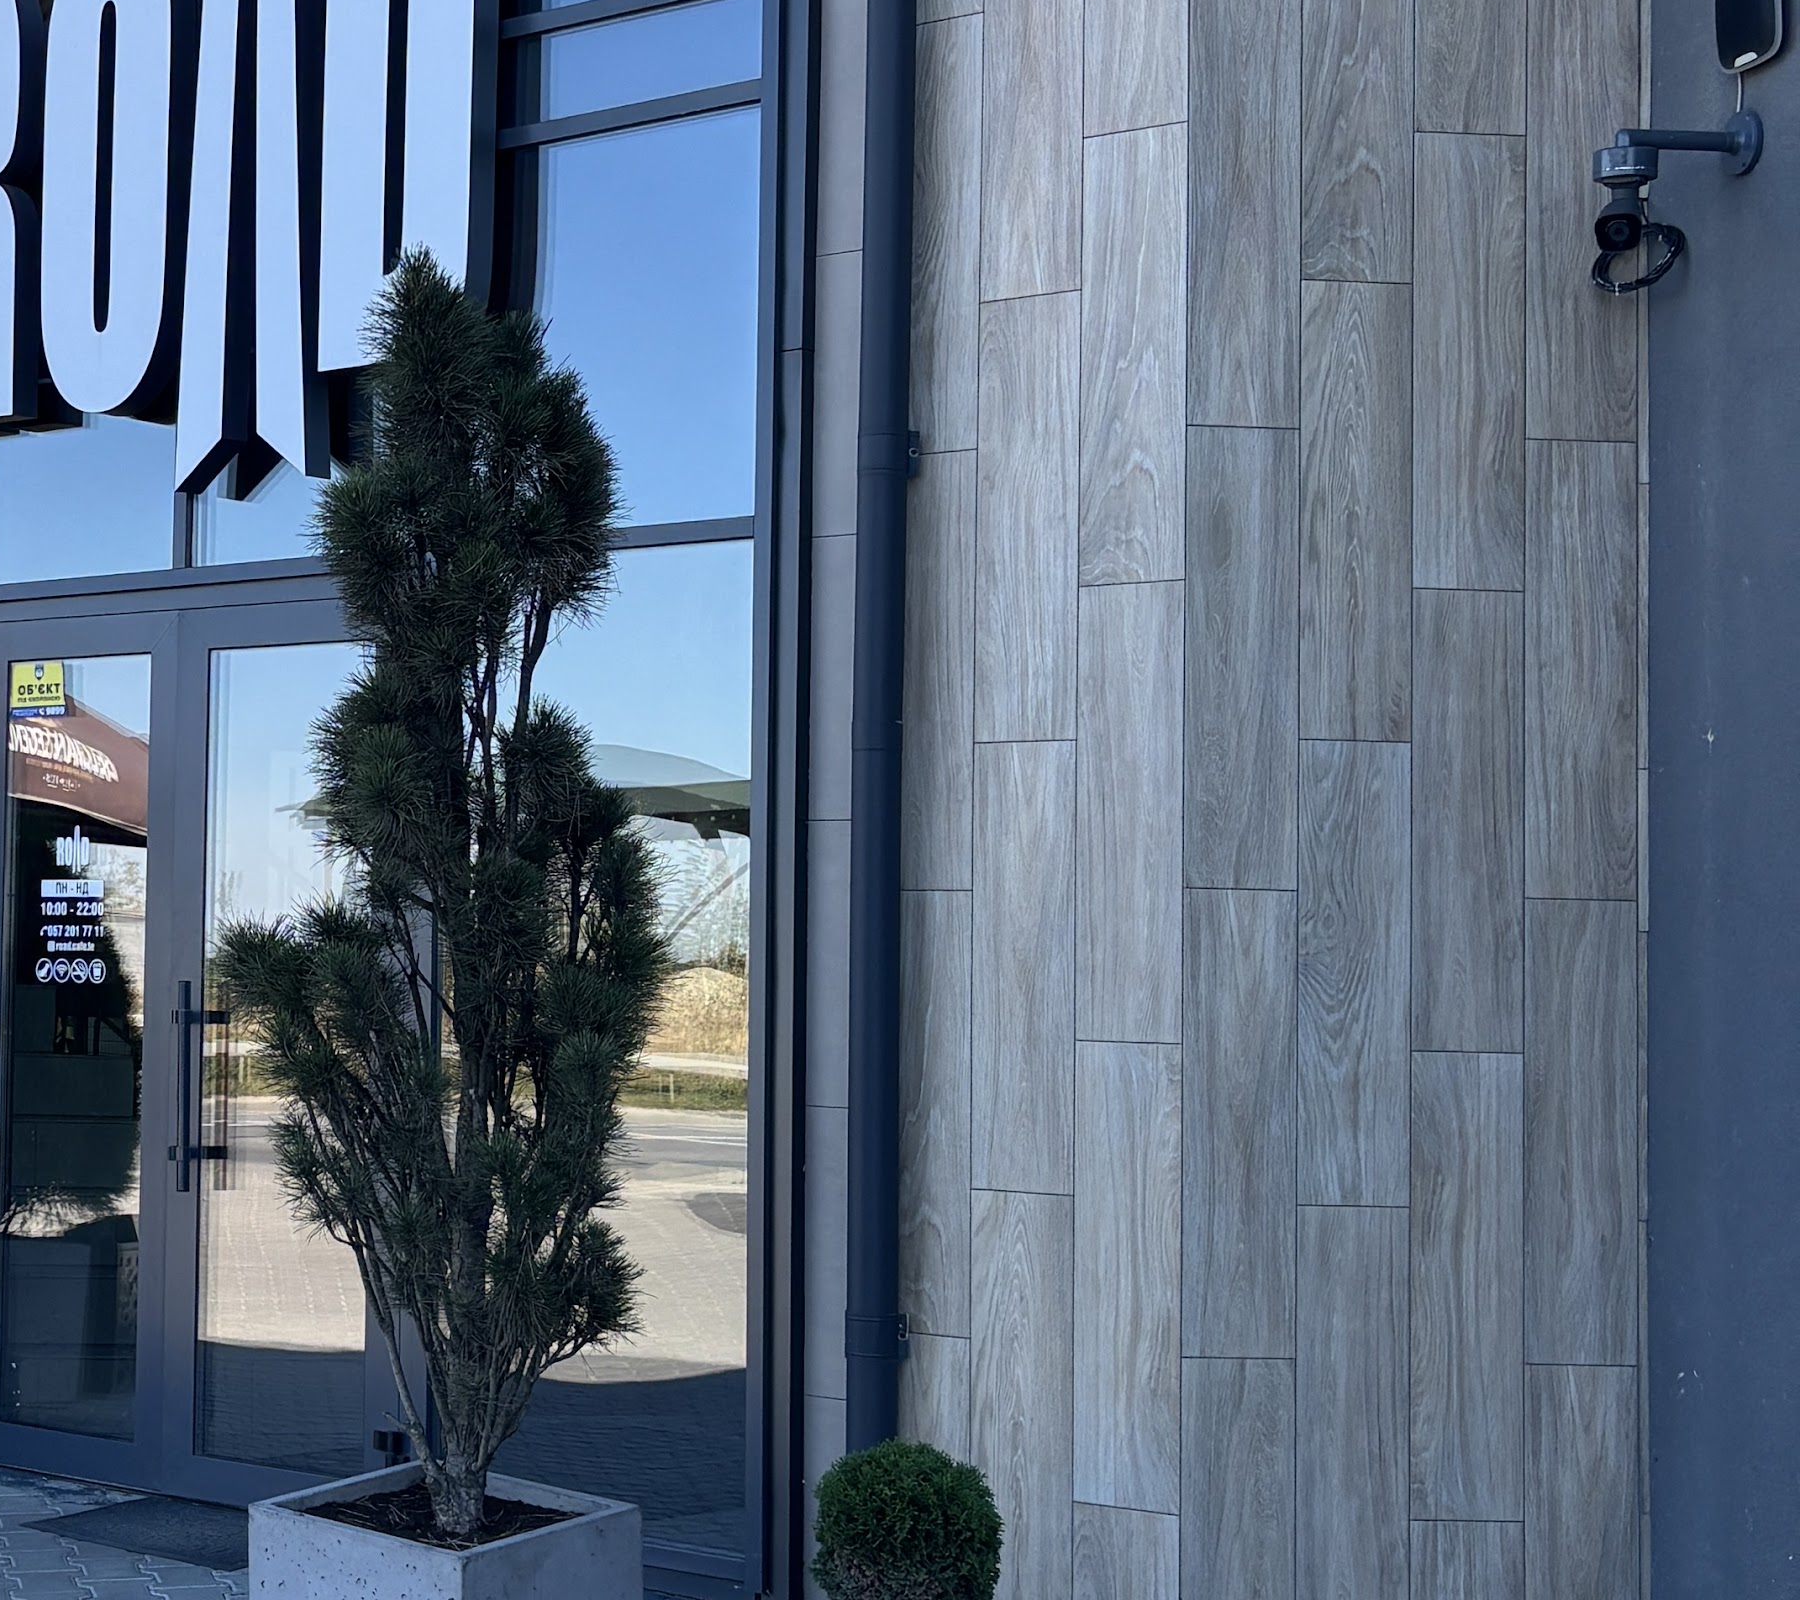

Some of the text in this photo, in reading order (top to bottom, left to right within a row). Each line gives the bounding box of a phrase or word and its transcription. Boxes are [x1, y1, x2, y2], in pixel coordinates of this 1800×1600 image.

[17, 682, 61, 696] ОБ'ЄКТ
[55, 824, 90, 874] ROAD
[55, 881, 68, 894] ПН
[76, 881, 89, 895] НД
[40, 901, 68, 916] 10:00
[76, 901, 104, 916] 22:00
[64, 924, 80, 937] 201
[82, 924, 93, 937] 77
[94, 925, 104, 937] 11
